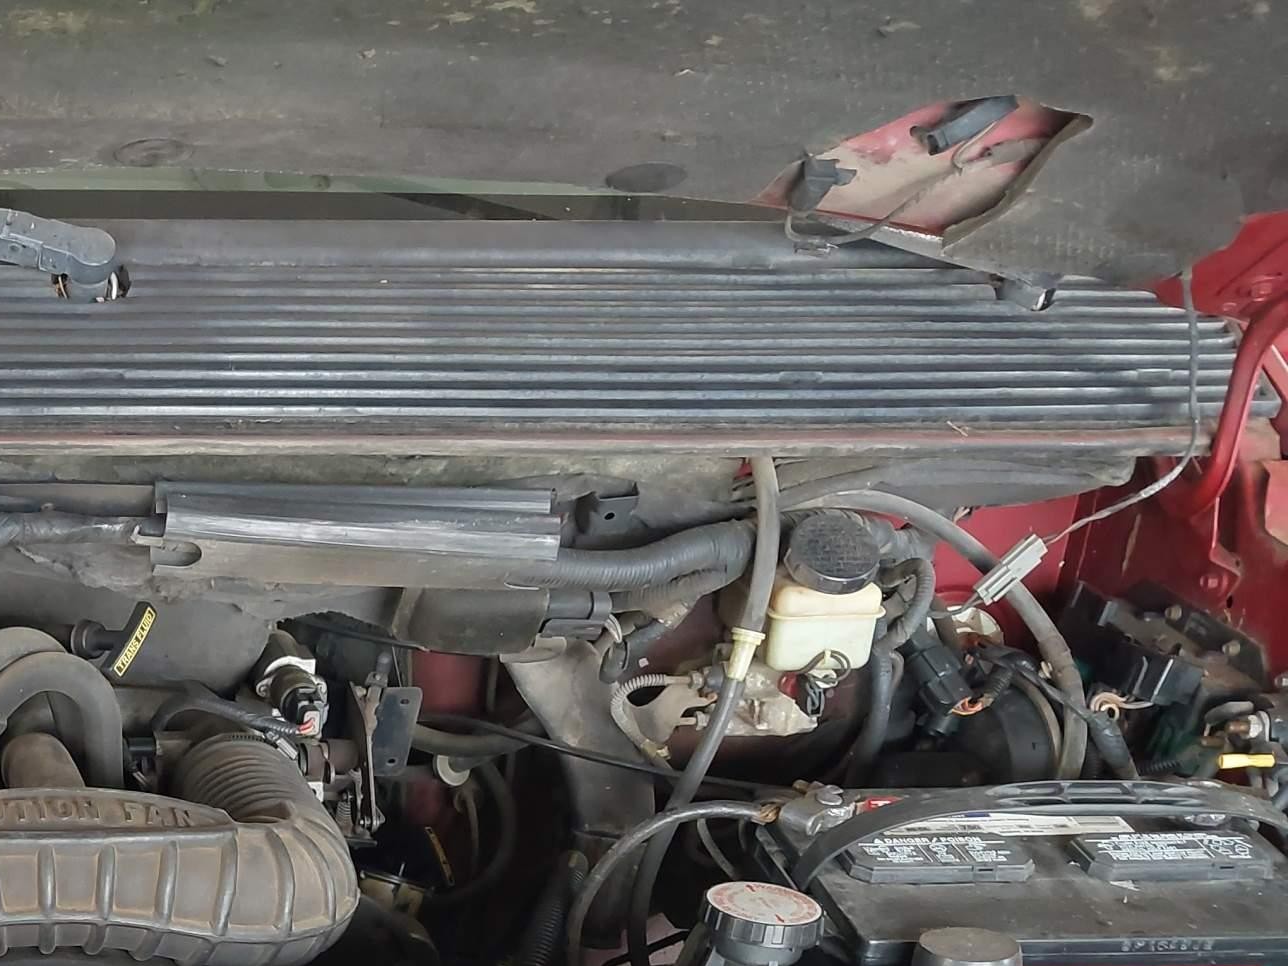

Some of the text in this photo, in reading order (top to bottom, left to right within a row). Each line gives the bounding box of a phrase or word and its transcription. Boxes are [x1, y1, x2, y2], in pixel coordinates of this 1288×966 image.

[118, 612, 153, 669] TRANS FLUID
[123, 802, 197, 827] FAN
